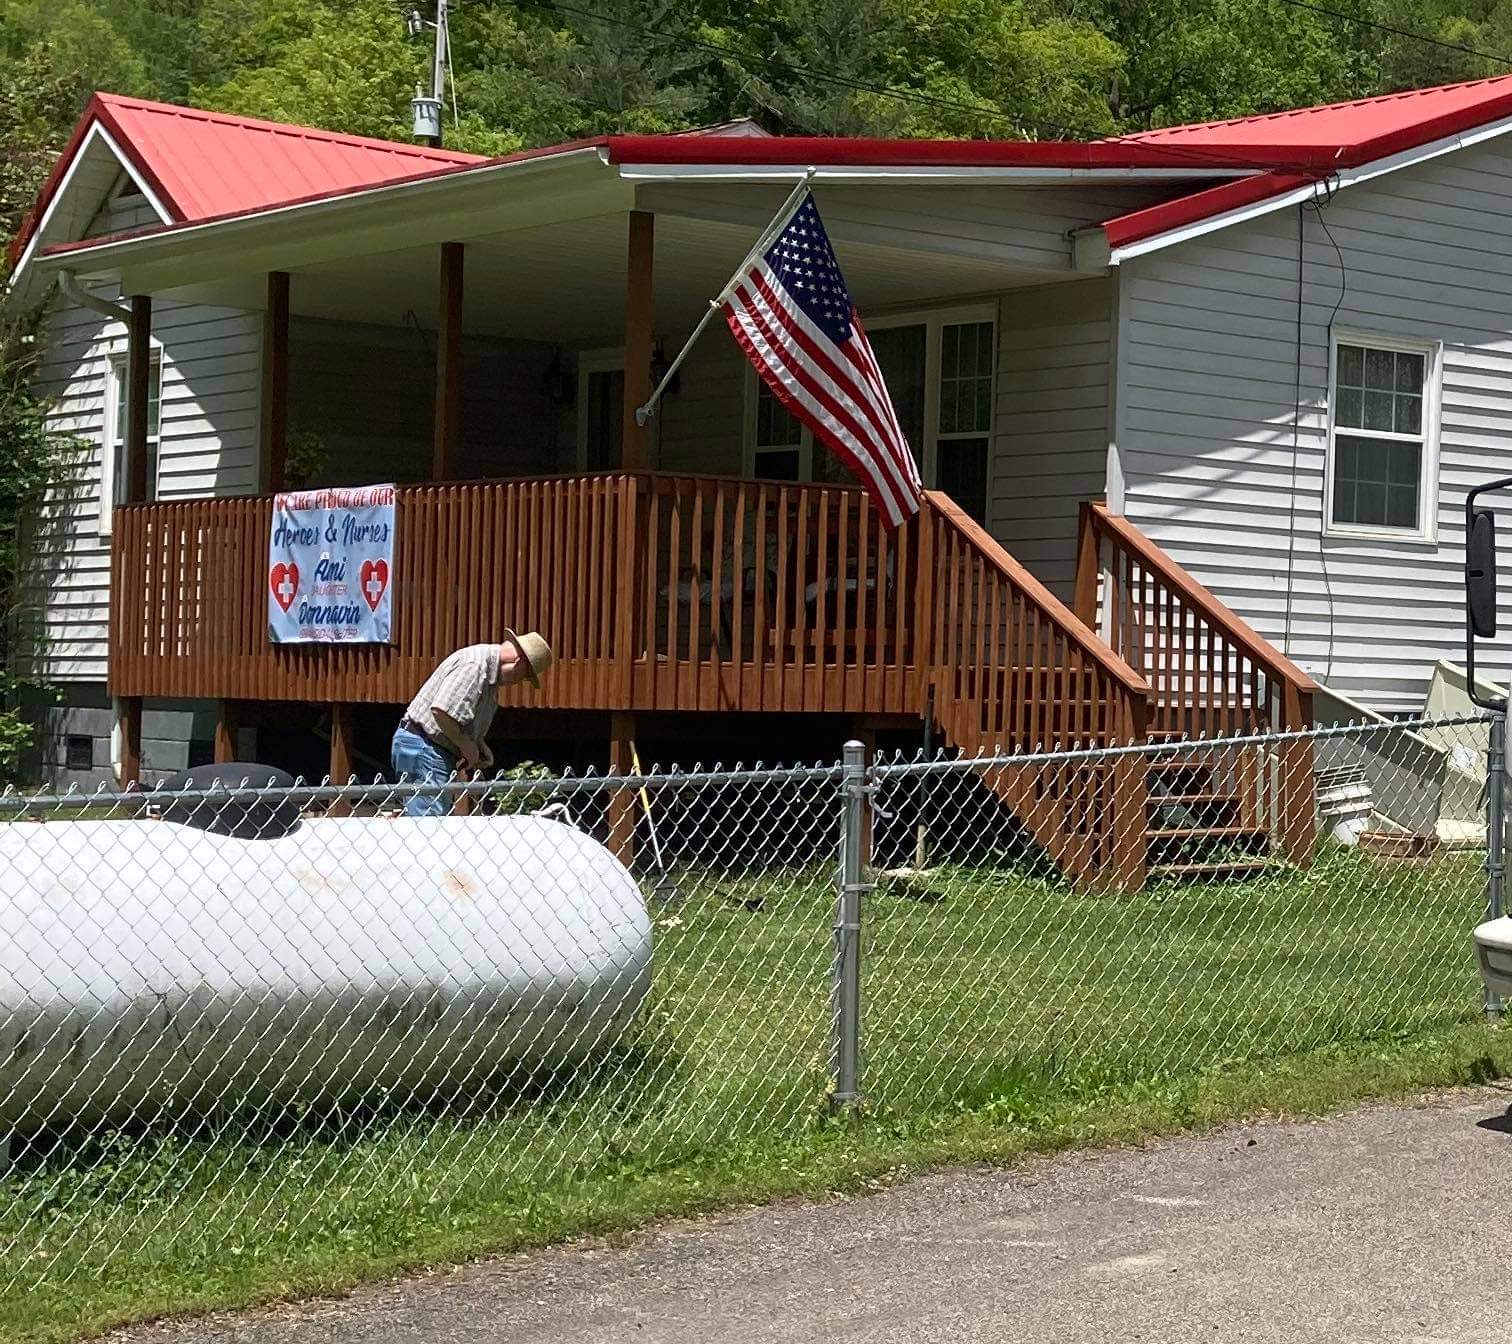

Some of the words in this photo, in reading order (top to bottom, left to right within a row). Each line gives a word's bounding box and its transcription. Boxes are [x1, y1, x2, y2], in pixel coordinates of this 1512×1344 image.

[369, 487, 393, 506] OUR
[274, 517, 320, 548] Heroes
[325, 513, 337, 543] &
[342, 513, 390, 546] Nurses
[314, 556, 347, 582] Ami
